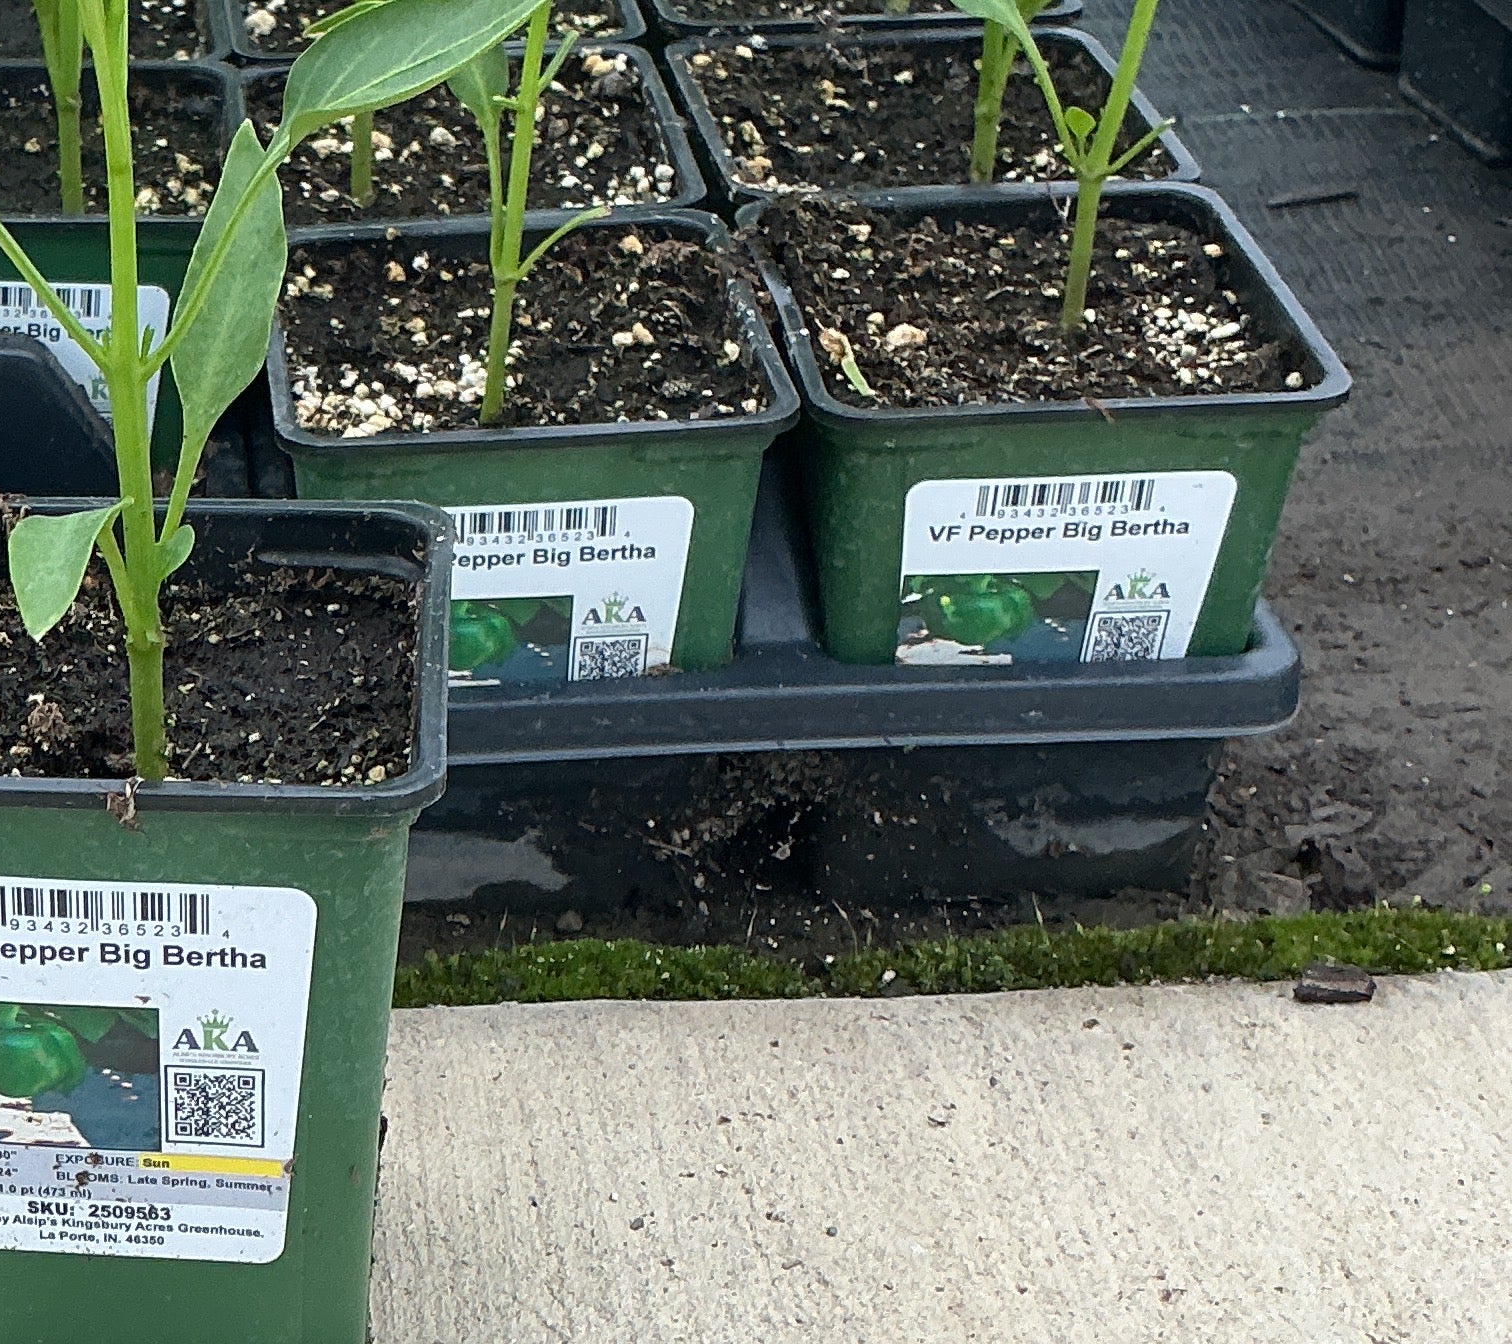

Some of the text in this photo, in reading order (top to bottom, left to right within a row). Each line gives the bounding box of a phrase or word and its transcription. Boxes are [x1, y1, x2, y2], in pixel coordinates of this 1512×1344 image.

[28, 323, 61, 342] Big
[929, 519, 1190, 544] VF Pepper Big Bertha
[533, 548, 571, 566] Big
[579, 544, 656, 562] Bertha
[1104, 582, 1170, 601] AKA
[582, 605, 646, 625] AKA
[10, 918, 88, 934] 93432
[102, 923, 181, 937] 36523
[100, 942, 151, 969] Big
[162, 945, 267, 969] Bertha
[172, 1026, 259, 1053] AKA
[142, 1158, 170, 1169] Sun
[56, 1171, 123, 1183] BLOMS:
[128, 1174, 158, 1185] Late
[216, 1178, 272, 1192] Summer
[21, 1187, 34, 1197] pt
[38, 1187, 66, 1198] (473
[28, 1200, 74, 1217] SKU:
[12, 1214, 57, 1227] Alsip's
[61, 1217, 131, 1233] Kingsbury
[135, 1221, 174, 1232] Acres
[40, 1230, 56, 1240] La
[125, 1234, 164, 1245] 46350
